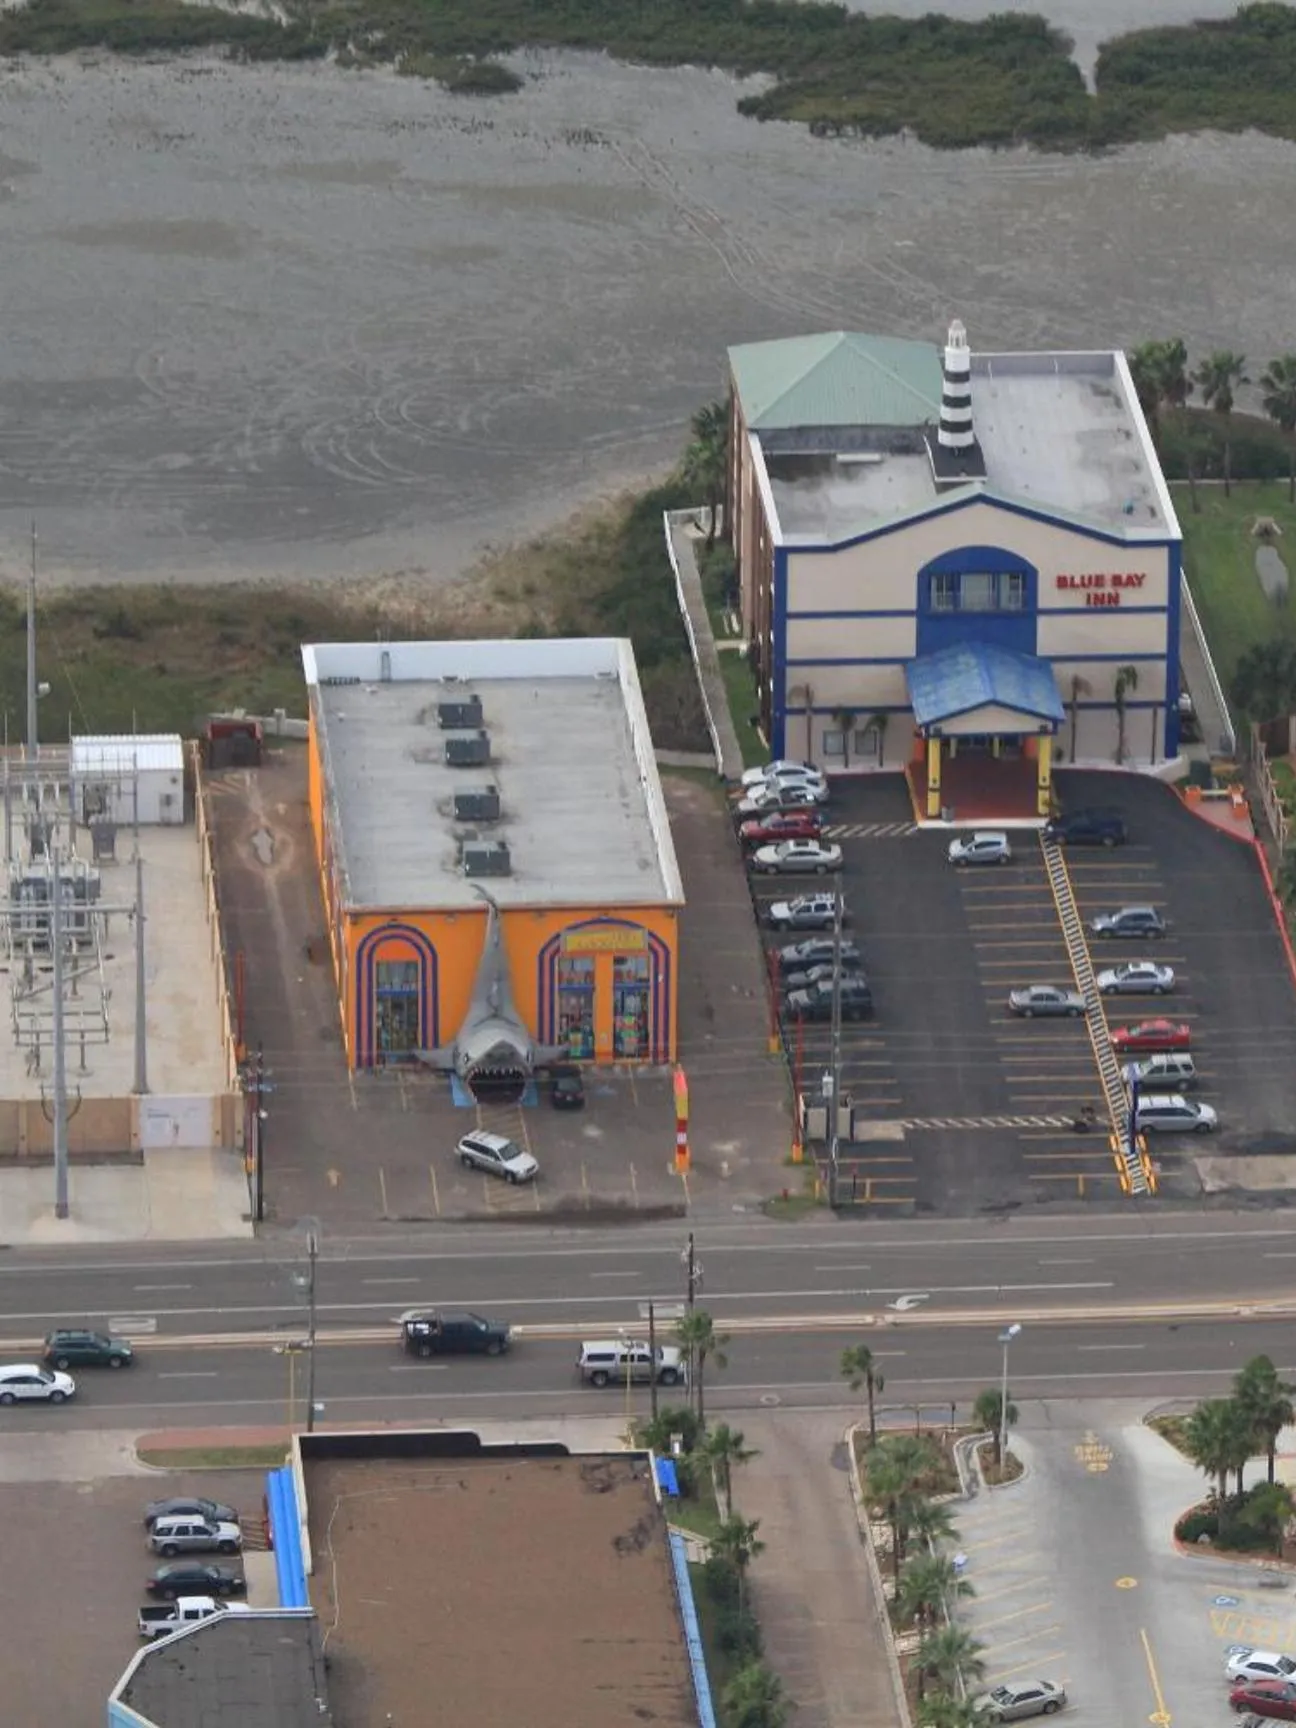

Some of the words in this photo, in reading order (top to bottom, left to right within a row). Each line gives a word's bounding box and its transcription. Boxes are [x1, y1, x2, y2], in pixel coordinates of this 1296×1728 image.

[1056, 574, 1105, 589] BLUE
[1111, 573, 1146, 588] BAY
[1086, 592, 1120, 605] INN
